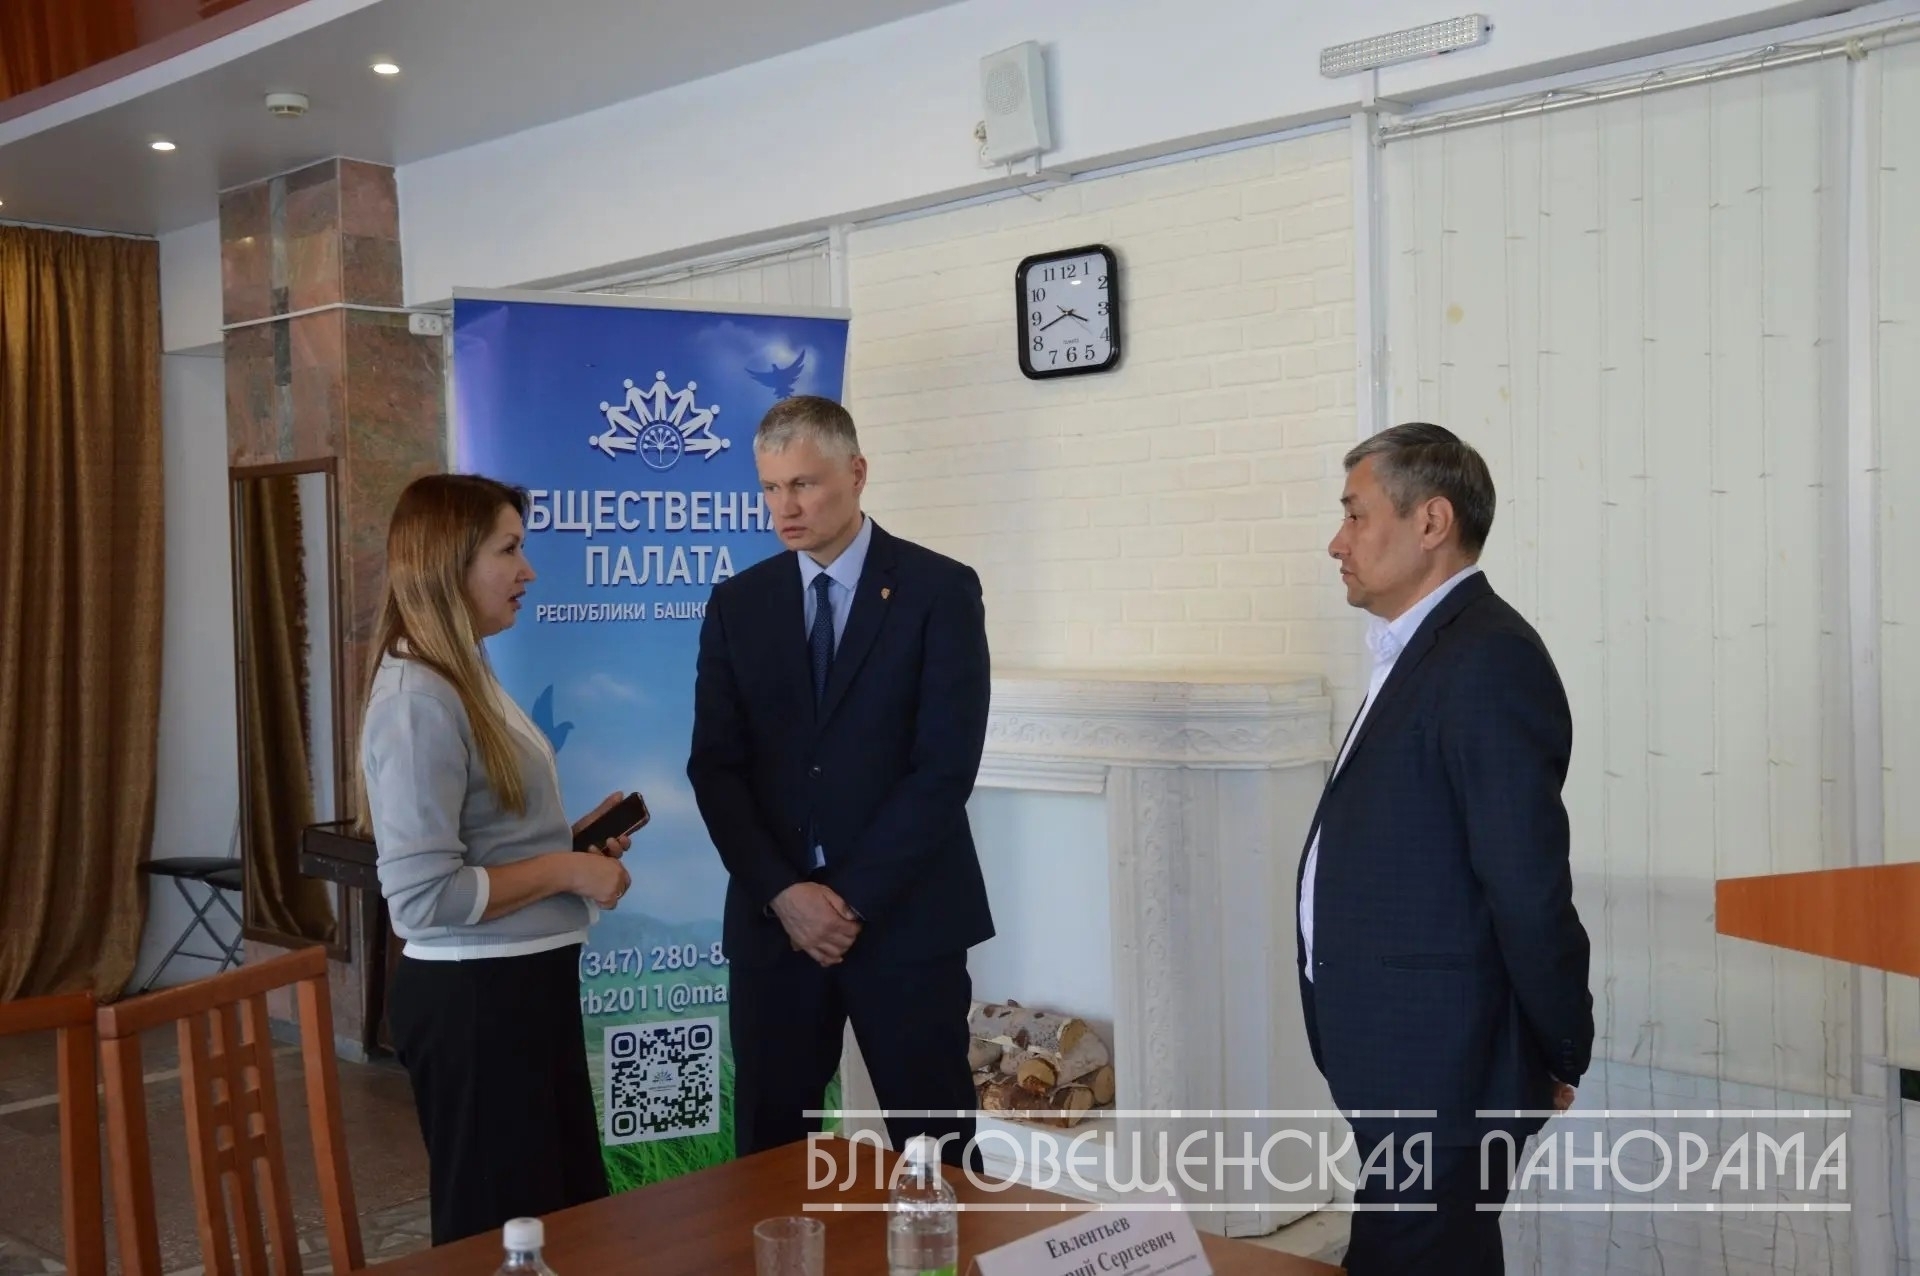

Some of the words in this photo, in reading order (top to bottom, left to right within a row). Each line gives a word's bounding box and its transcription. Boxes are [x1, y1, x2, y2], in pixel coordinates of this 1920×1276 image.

[1043, 267, 1055, 282] 11
[1060, 264, 1076, 280] 12
[1083, 261, 1089, 275] 1
[1098, 275, 1108, 290] 2
[1032, 287, 1046, 302] 10
[1098, 301, 1111, 316] 3
[1032, 311, 1042, 326] 9
[1100, 326, 1110, 341] 4
[1033, 336, 1044, 352] 8
[1084, 344, 1095, 360] 5
[1048, 350, 1058, 365] 7
[1066, 346, 1077, 362] 6
[527, 489, 775, 538] БЩЕСТВЕНН
[586, 545, 735, 585] ПАЛАТА
[536, 602, 646, 622] РЕСПУБЛИКИ
[579, 946, 643, 983] (347)
[651, 942, 730, 971] 280-8
[1046, 1217, 1131, 1259] Евлентьев
[1098, 1230, 1176, 1271] Сергеевич
